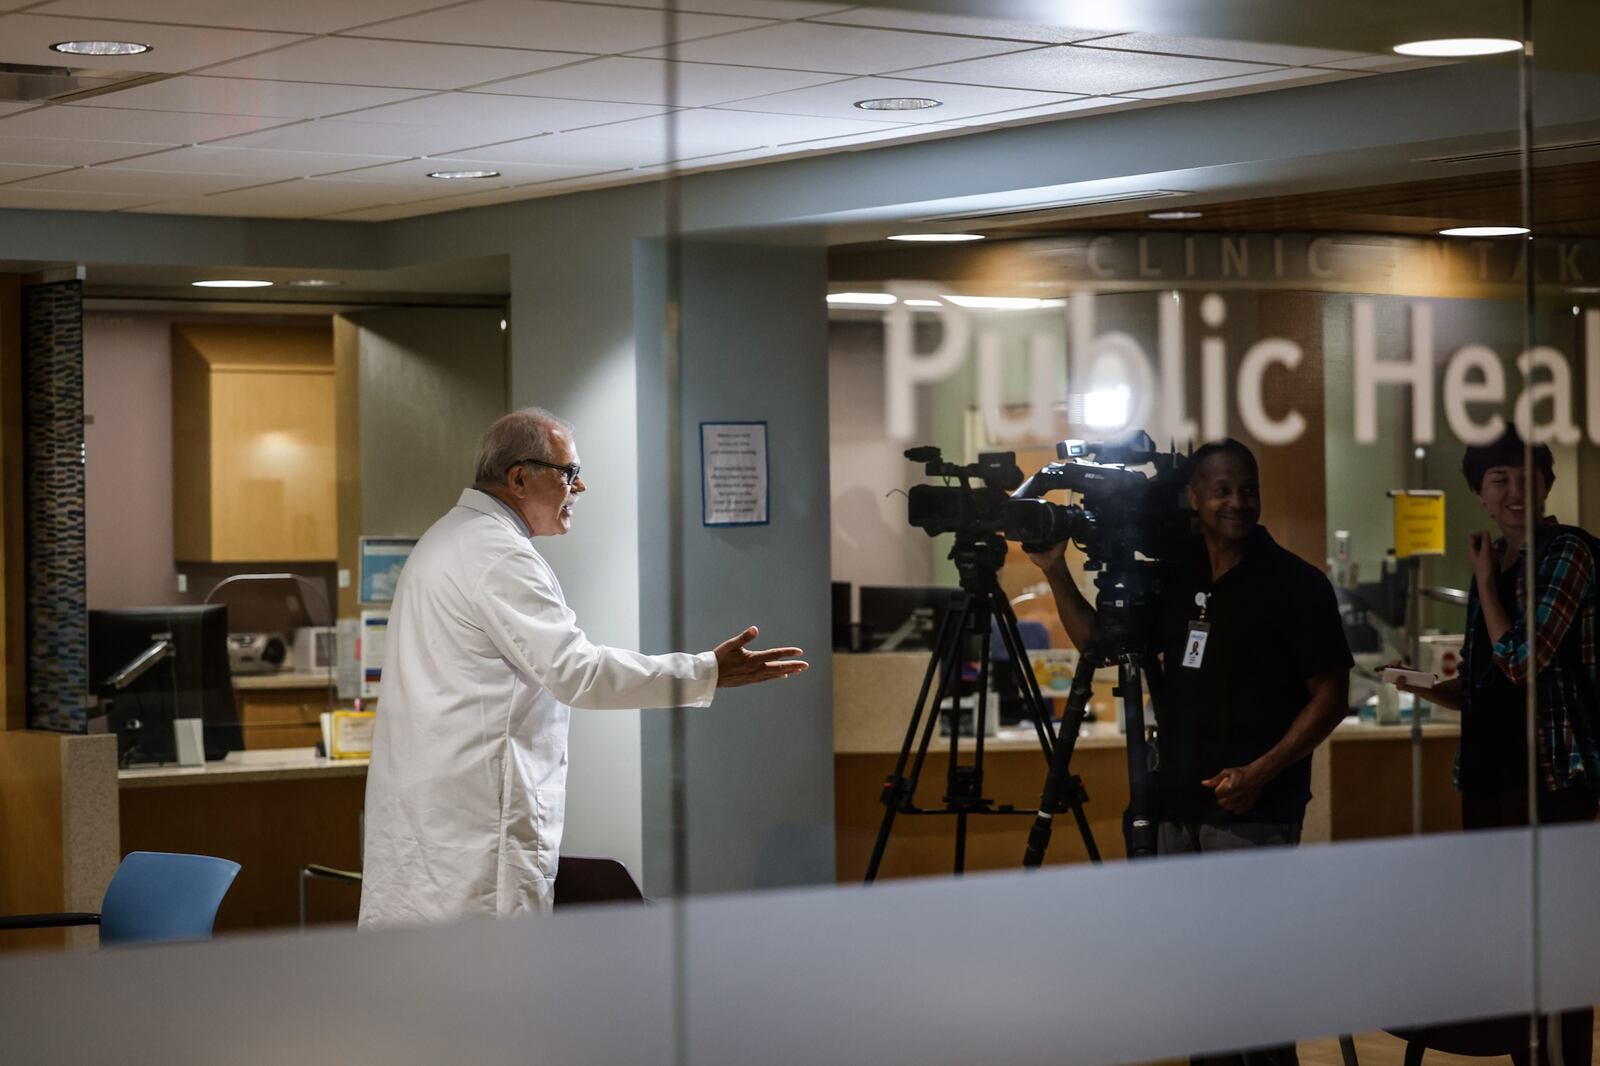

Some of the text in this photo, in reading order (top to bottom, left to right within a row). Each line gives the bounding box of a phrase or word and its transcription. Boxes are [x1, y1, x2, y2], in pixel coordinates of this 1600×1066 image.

[1086, 236, 1584, 282] CLINIC NTAK
[882, 279, 1308, 447] Public
